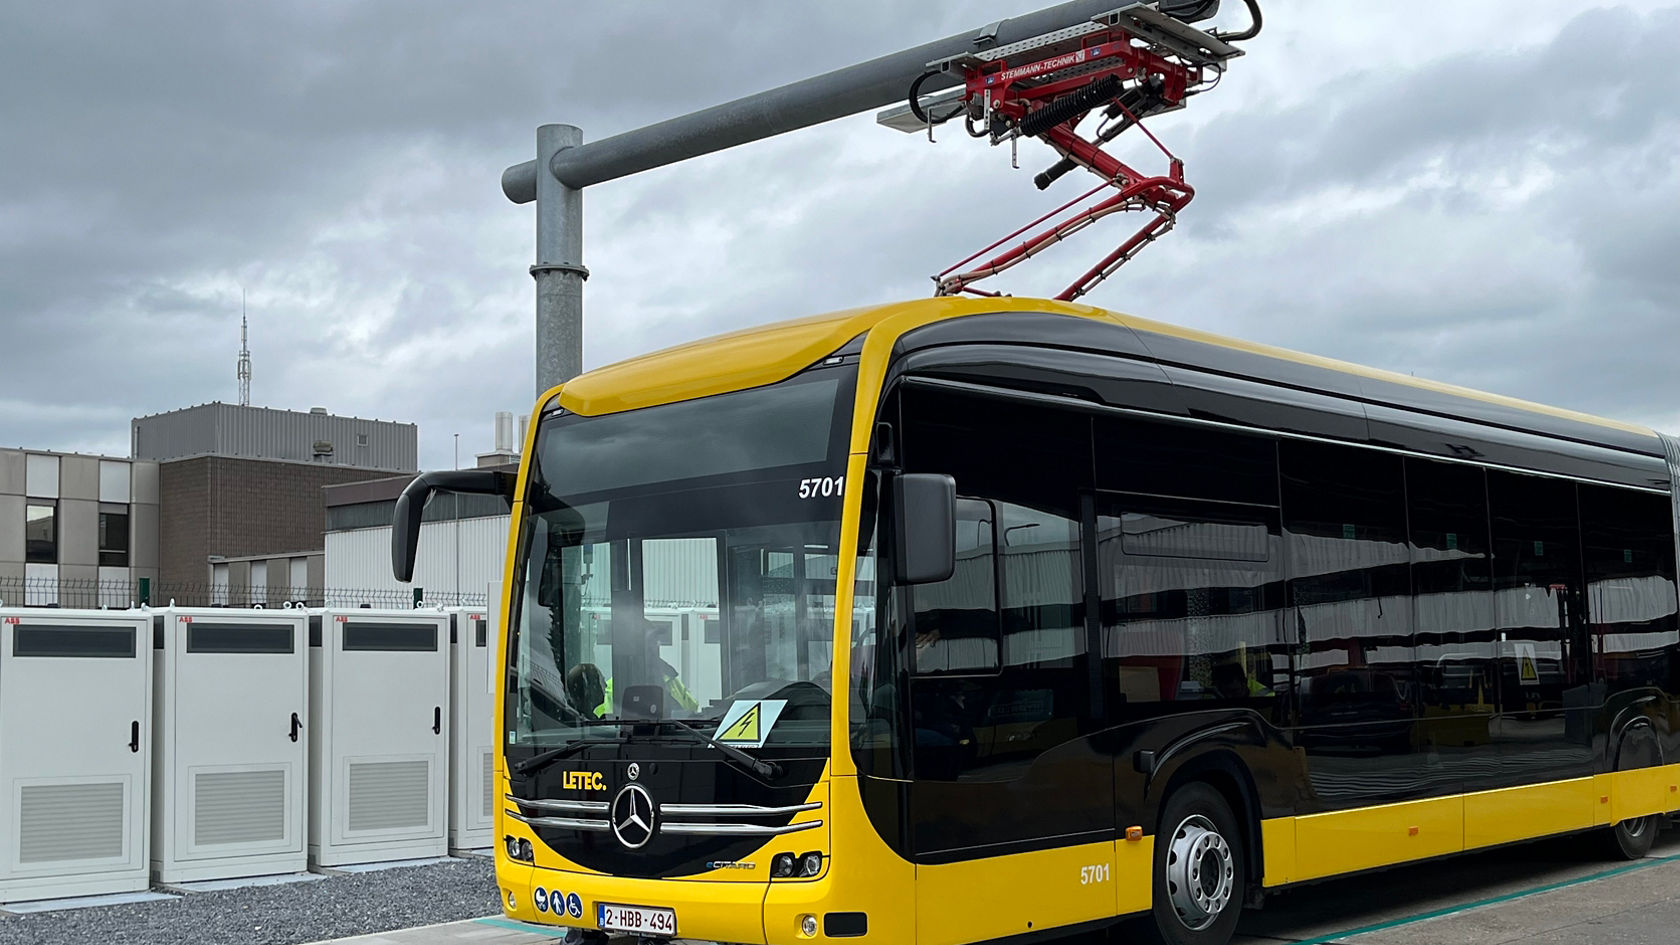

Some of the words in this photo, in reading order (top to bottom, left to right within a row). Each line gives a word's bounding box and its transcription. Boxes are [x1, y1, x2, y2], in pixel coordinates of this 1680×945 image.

[1001, 54, 1076, 81] STEMMANN-TECHNIK
[799, 476, 844, 499] 5701
[563, 771, 607, 791] LETEC.
[1080, 863, 1110, 885] 5701
